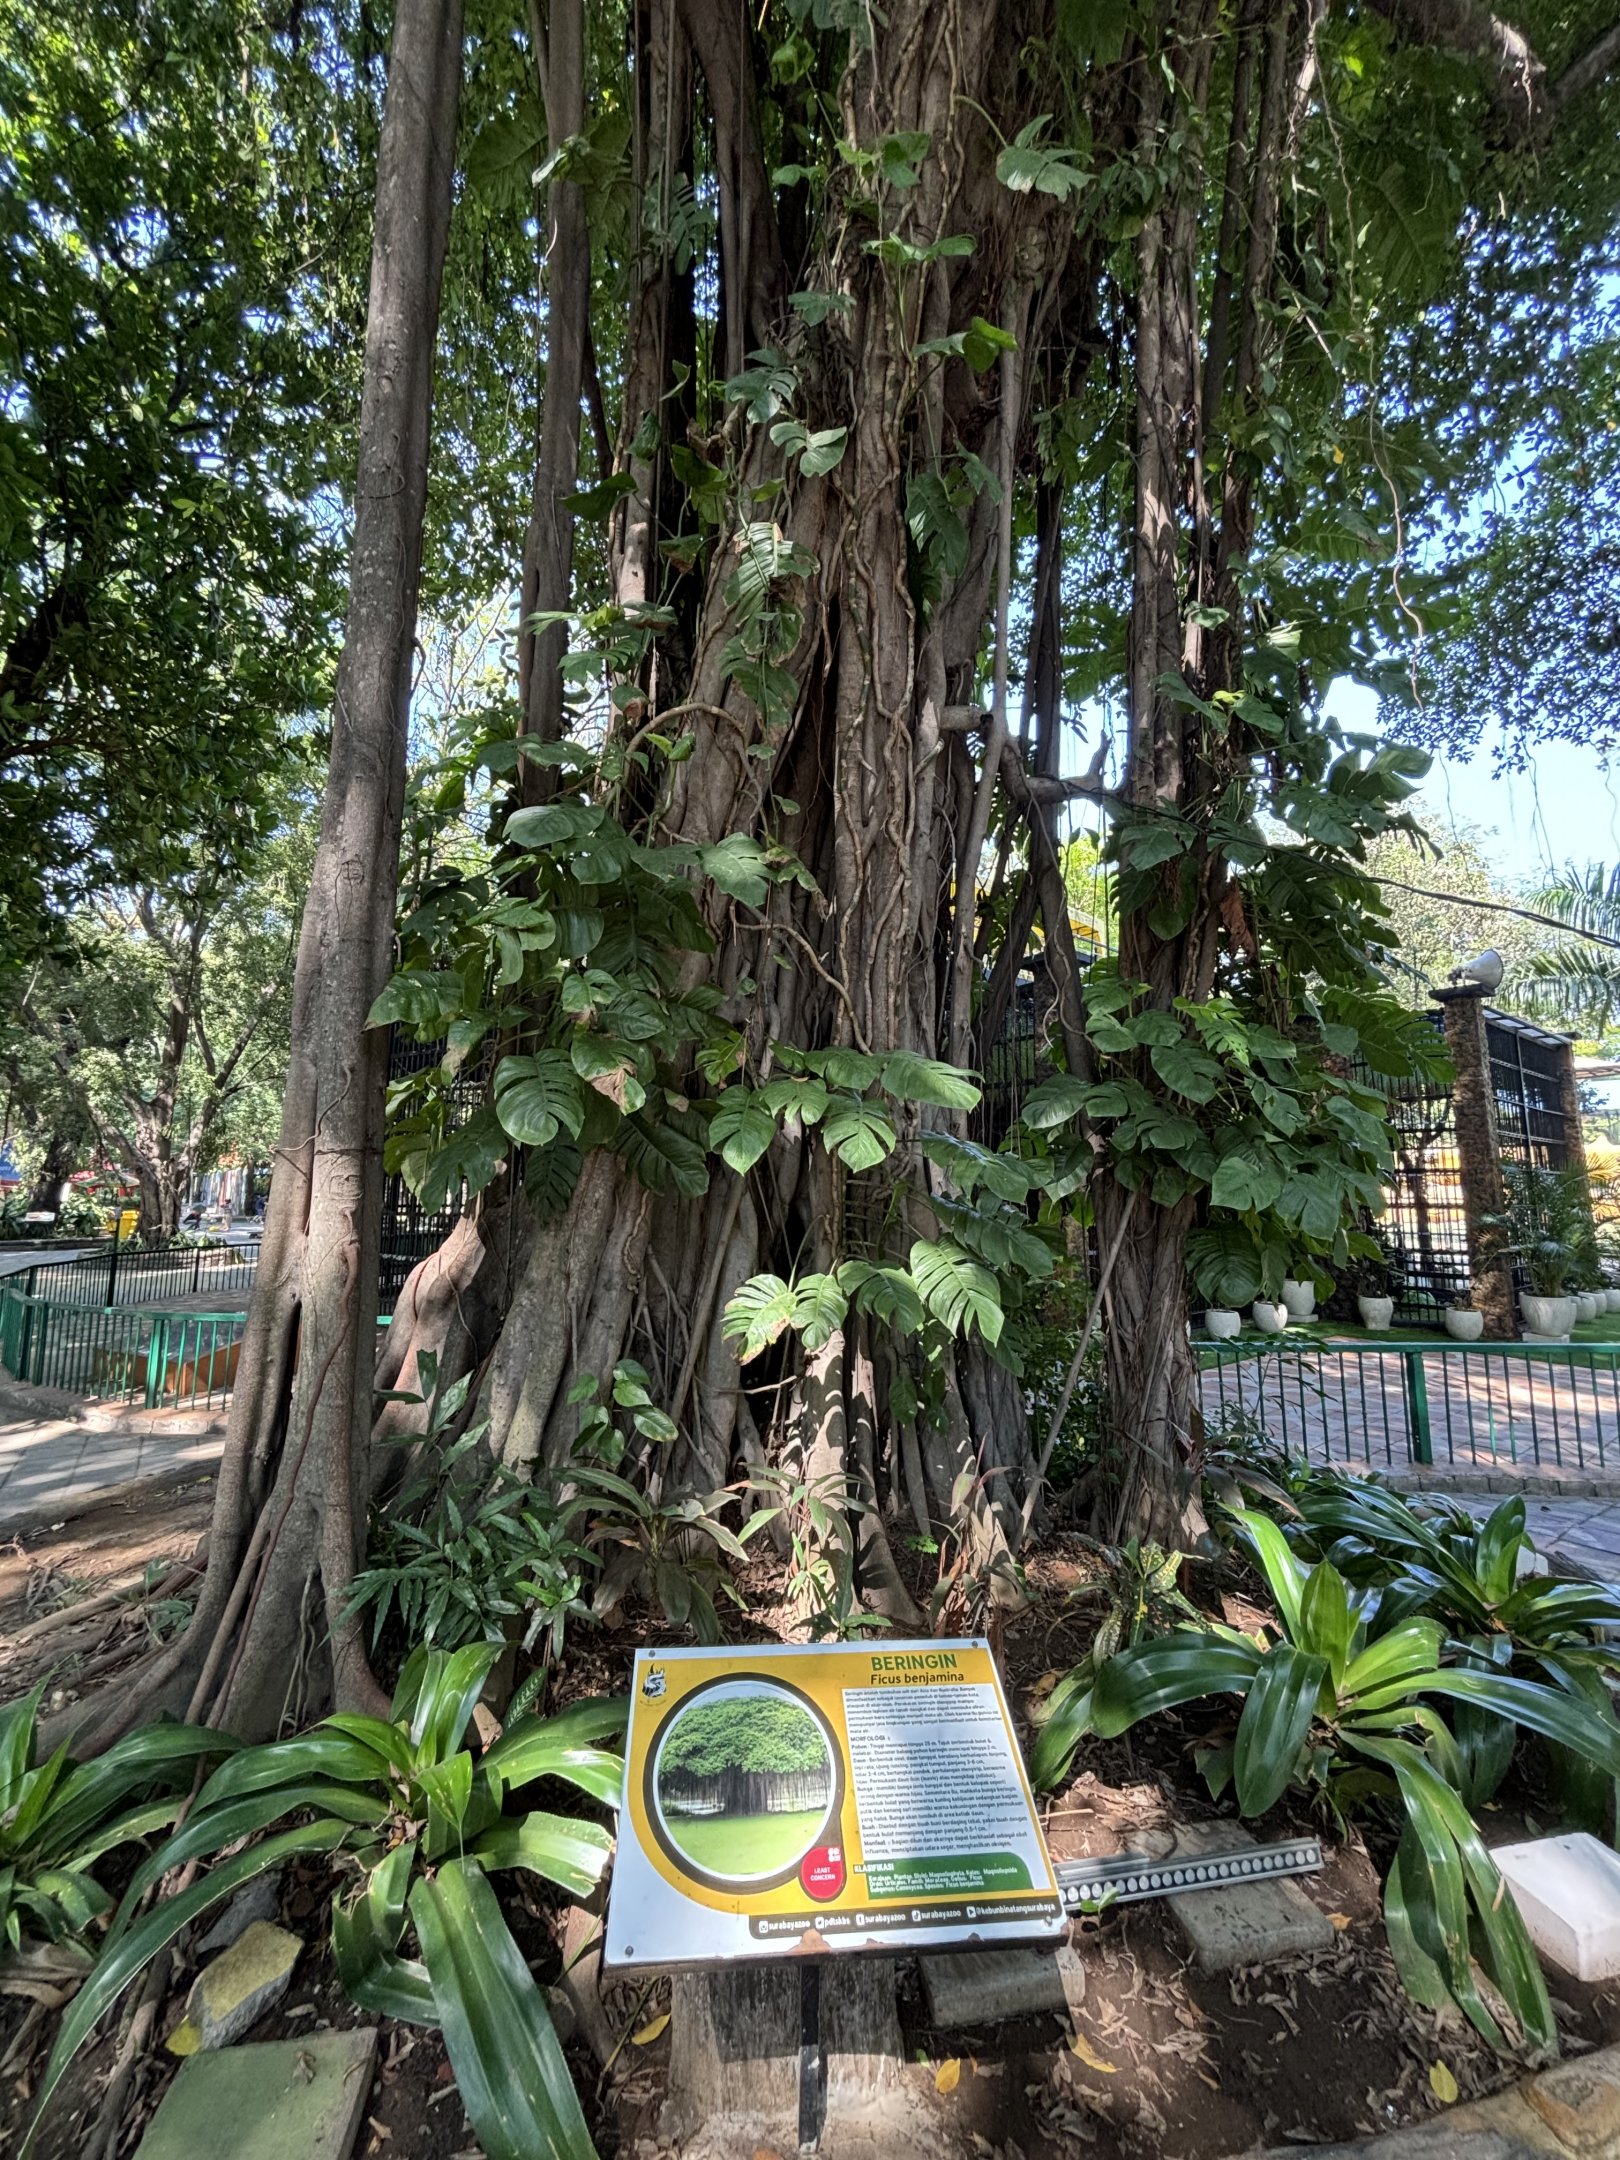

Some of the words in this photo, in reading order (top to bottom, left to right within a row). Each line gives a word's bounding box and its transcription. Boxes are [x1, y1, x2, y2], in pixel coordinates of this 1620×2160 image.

[871, 1654, 957, 1671] BERINGIN
[871, 1674, 901, 1685] Ficus
[904, 1671, 965, 1686] benjamina
[854, 1863, 894, 1873] KLASIFIKASI
[768, 1920, 811, 1931] surabayazoo
[864, 1913, 906, 1924] surabayazoo
[921, 1910, 962, 1919] surabayazoo
[976, 1902, 1056, 1915] @kebunbinatangsurabaya
